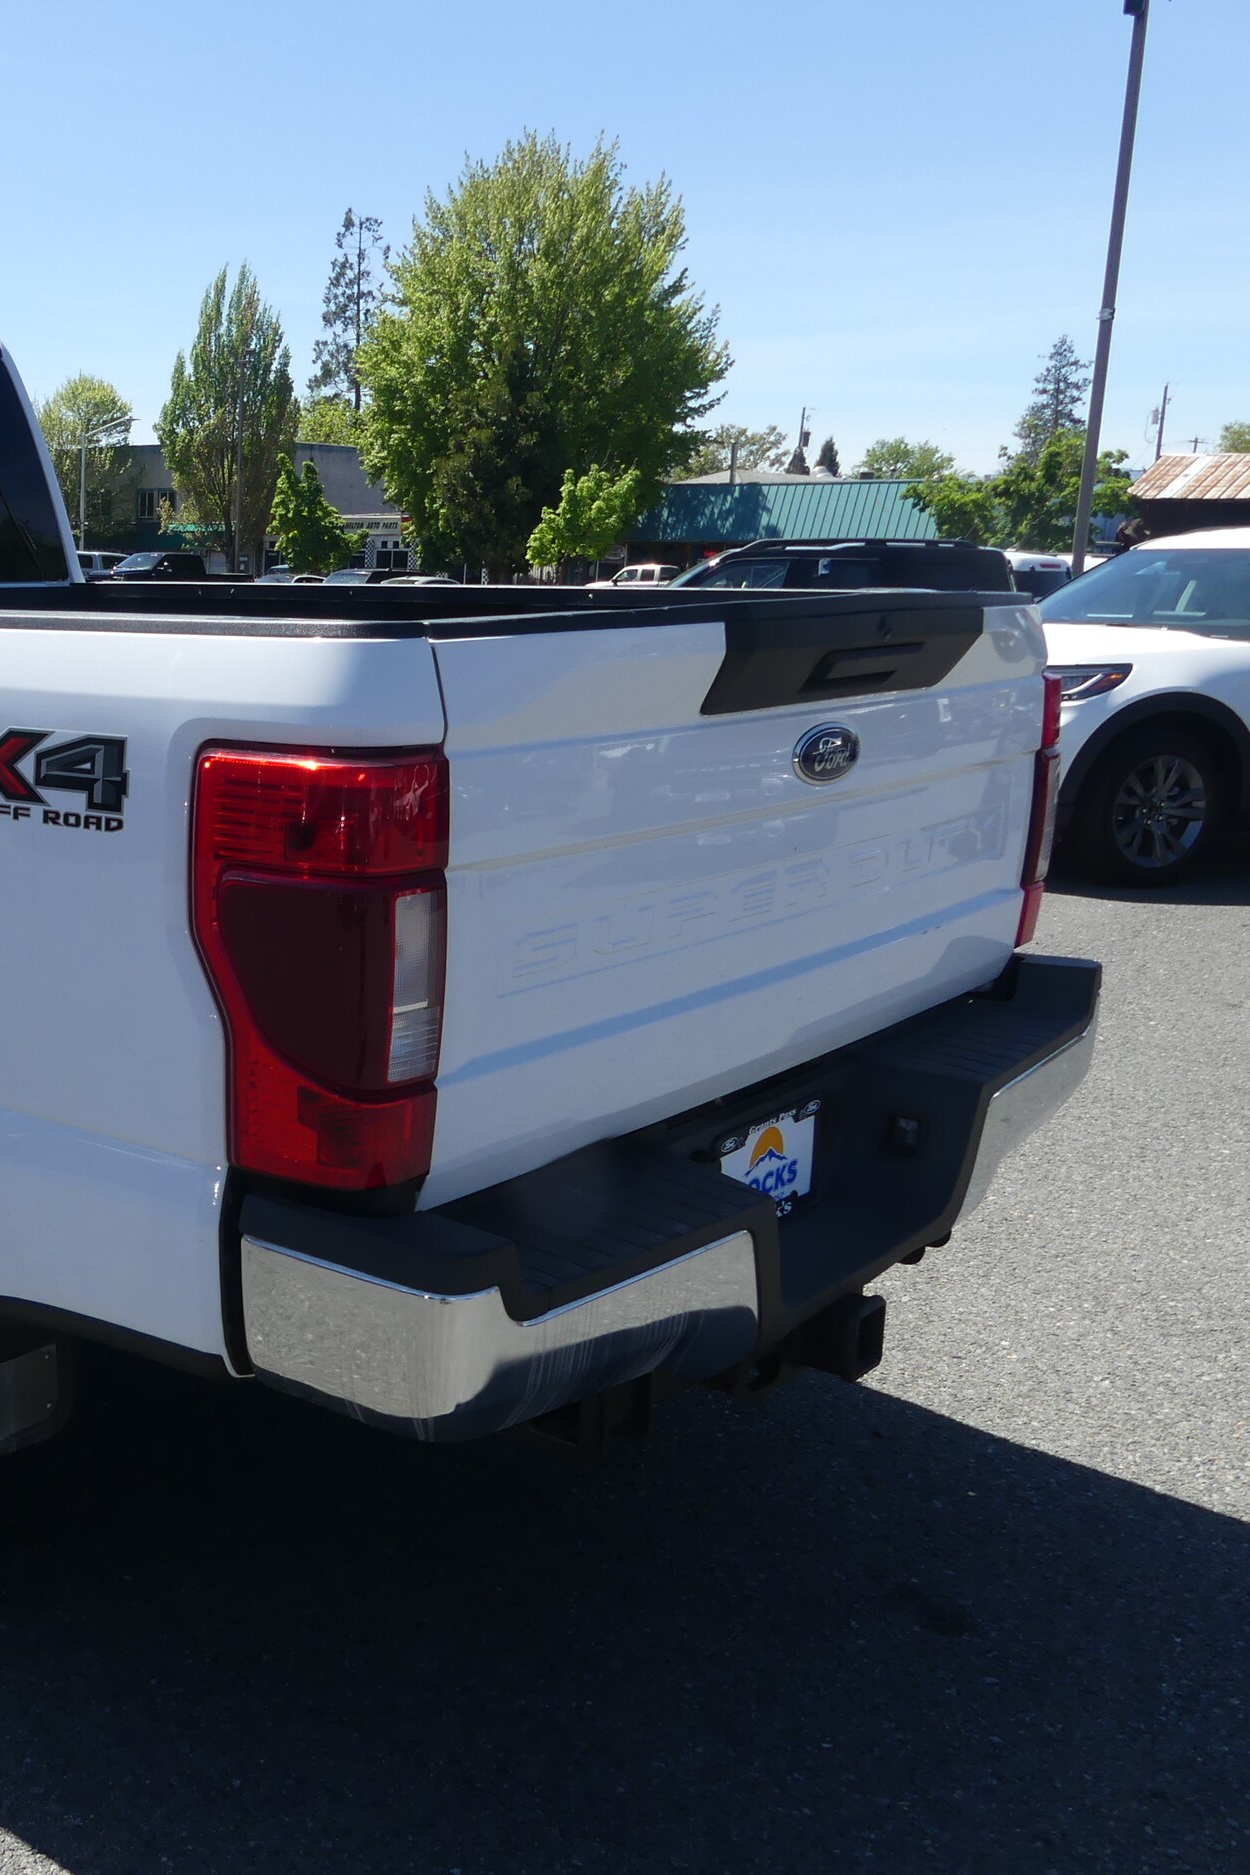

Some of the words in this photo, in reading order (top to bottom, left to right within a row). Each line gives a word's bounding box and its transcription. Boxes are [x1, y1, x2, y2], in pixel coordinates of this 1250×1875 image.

[366, 521, 380, 529] AUTO
[382, 521, 398, 529] PARTS
[41, 808, 125, 833] ROAD
[511, 858, 830, 979] SUPER
[749, 1158, 799, 1195] OCKS
